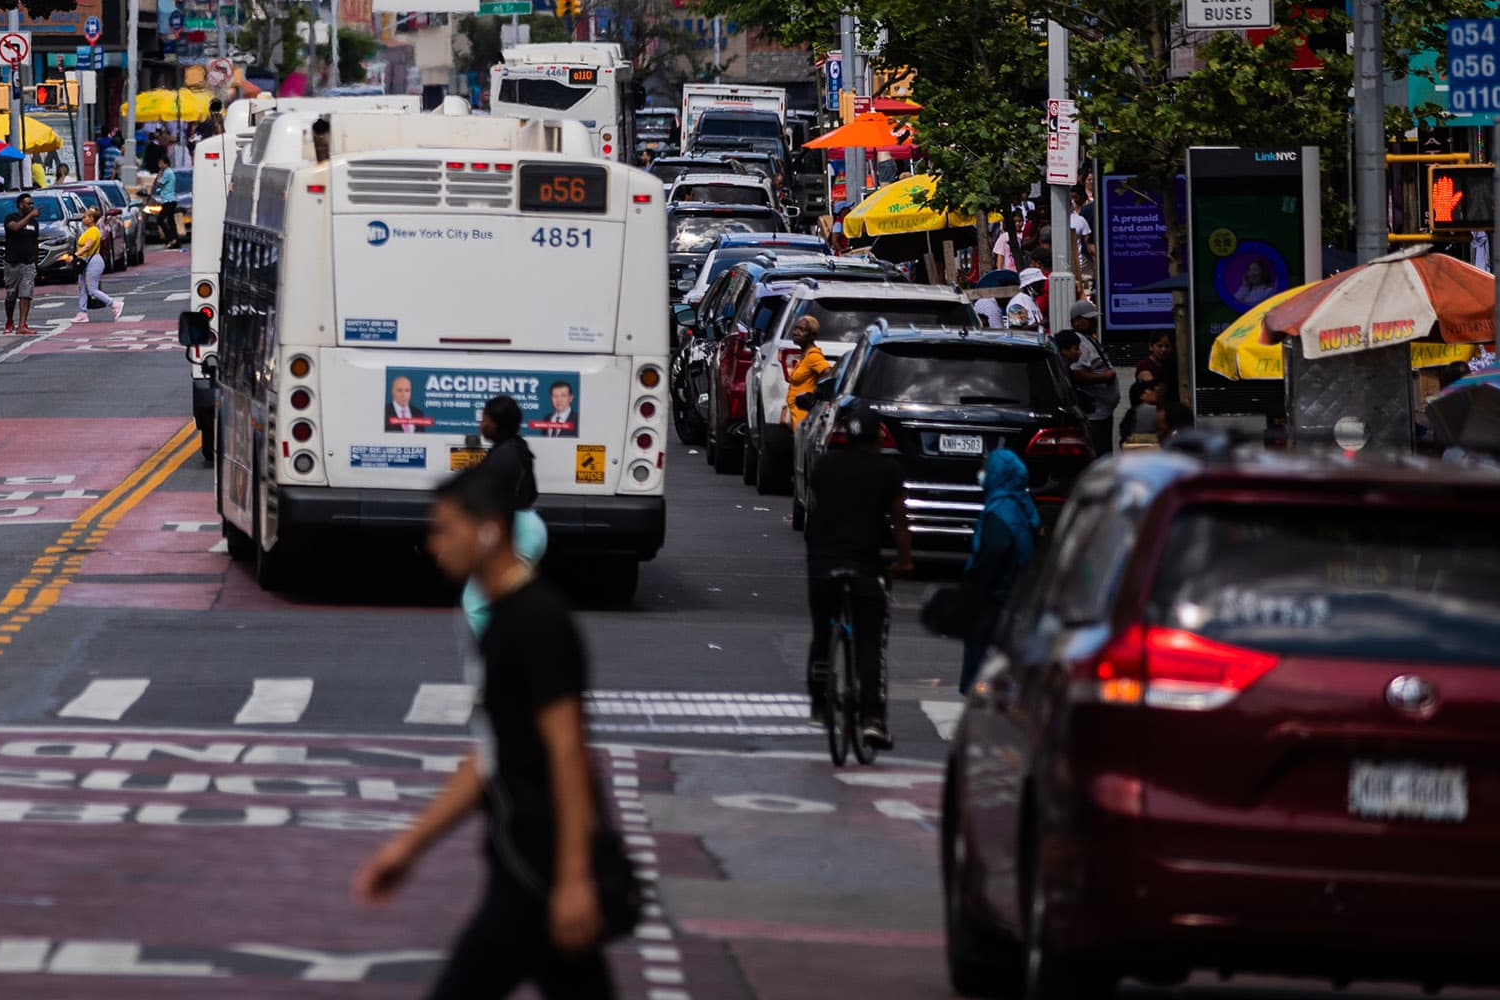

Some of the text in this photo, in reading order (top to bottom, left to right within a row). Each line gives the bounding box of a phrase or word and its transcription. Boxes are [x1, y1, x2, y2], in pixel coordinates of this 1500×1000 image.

[1205, 8, 1252, 21] BUSES
[1452, 23, 1495, 46] Q54
[1452, 54, 1495, 78] Q56
[1255, 152, 1297, 162] LinkNYC
[1121, 213, 1158, 224] prepaid
[392, 228, 416, 238] New
[419, 228, 443, 238] York
[447, 229, 469, 241] City
[472, 229, 493, 240] Bus
[532, 227, 593, 248] 4851
[1319, 320, 1414, 351] NUTS NUTS
[426, 375, 539, 393] ACCIDENT?
